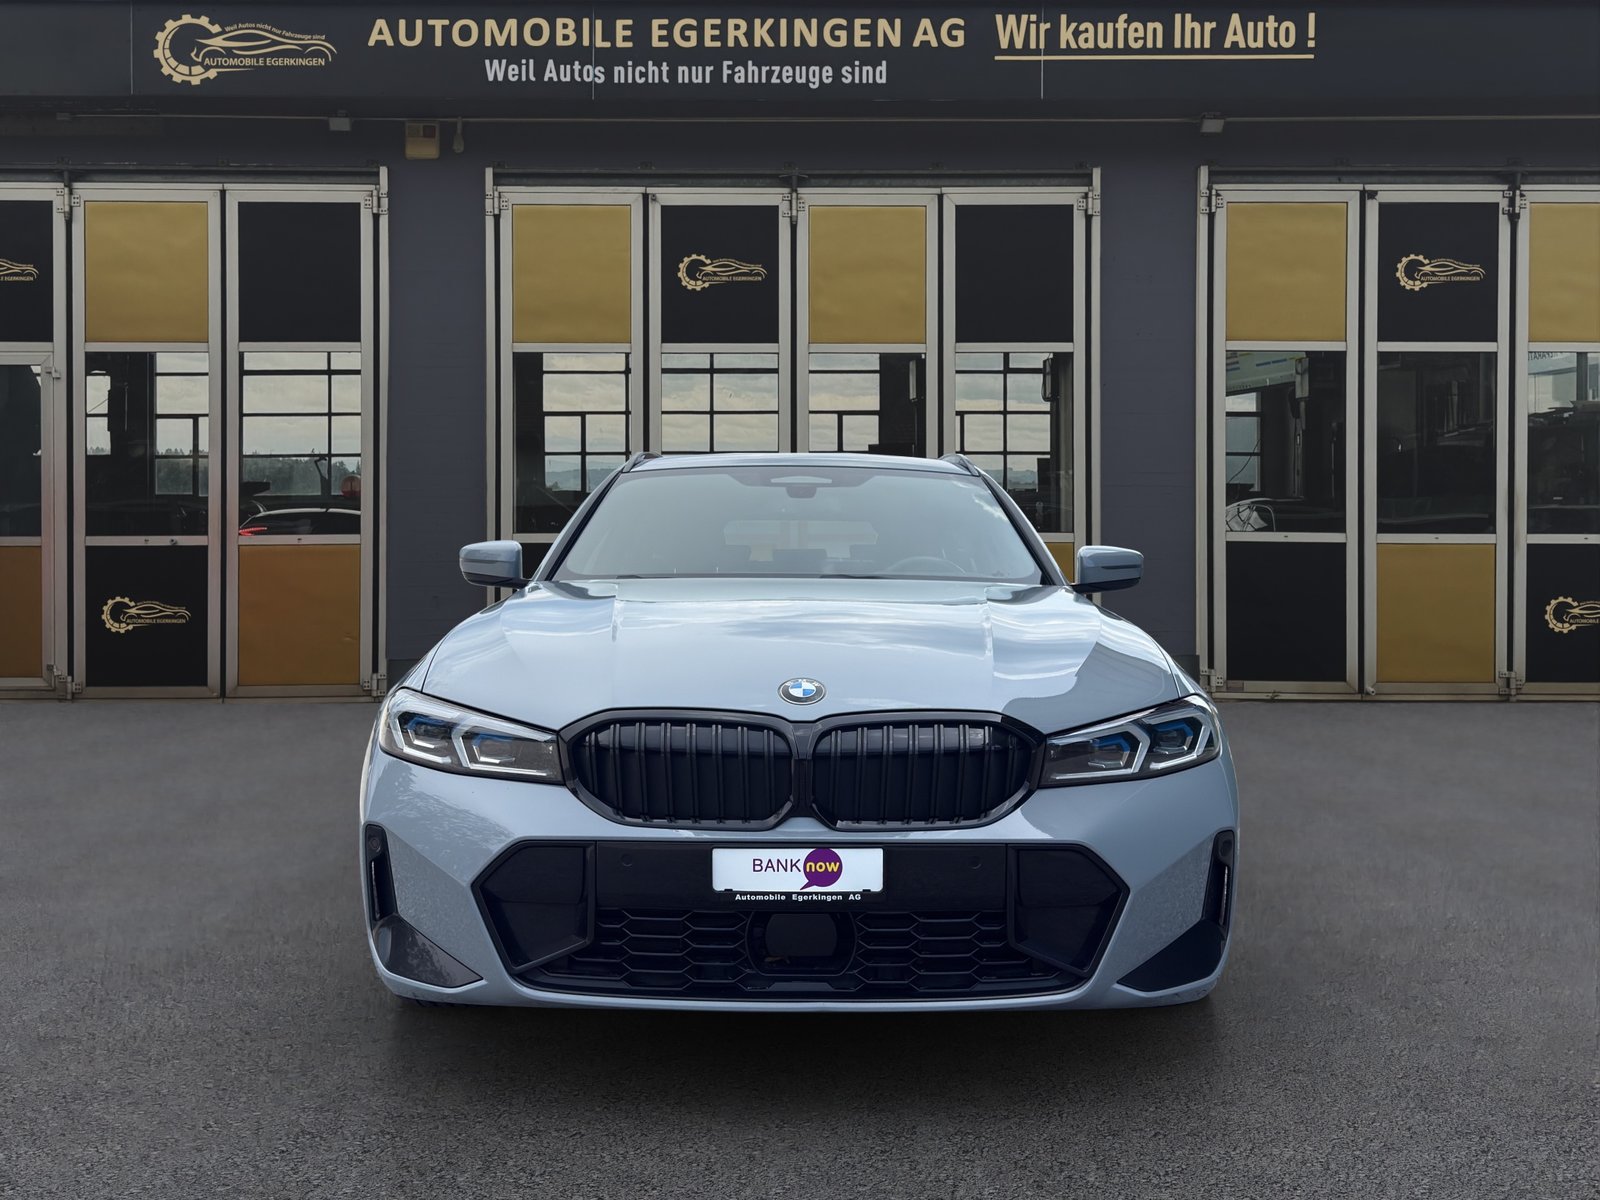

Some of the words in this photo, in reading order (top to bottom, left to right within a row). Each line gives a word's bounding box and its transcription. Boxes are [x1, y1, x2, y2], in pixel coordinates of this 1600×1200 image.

[224, 24, 237, 32] Weil
[256, 22, 272, 31] nicht
[271, 27, 282, 35] nur
[282, 31, 311, 40] Fahrzeuge
[367, 17, 633, 48] AUTOMOBILE
[651, 17, 902, 48] EGERKINGEN
[911, 17, 966, 48] AG
[995, 13, 1051, 49] Wir
[1059, 13, 1164, 49] kaufen
[1174, 13, 1217, 49] Ihr
[1223, 12, 1297, 49] Auto
[203, 57, 264, 66] AUTOMOBILE
[266, 57, 325, 66] EGERKINGEN
[484, 58, 536, 82] Weil
[543, 58, 606, 84] Autos
[613, 60, 670, 84] nicht
[677, 64, 714, 84] nur
[722, 60, 834, 89] Fahrzeuge
[840, 60, 887, 84] sind
[752, 858, 801, 873] BANK
[805, 861, 840, 873] now
[735, 893, 786, 901] Automobile
[792, 893, 843, 902] Egerkingen
[848, 893, 861, 901] AG
